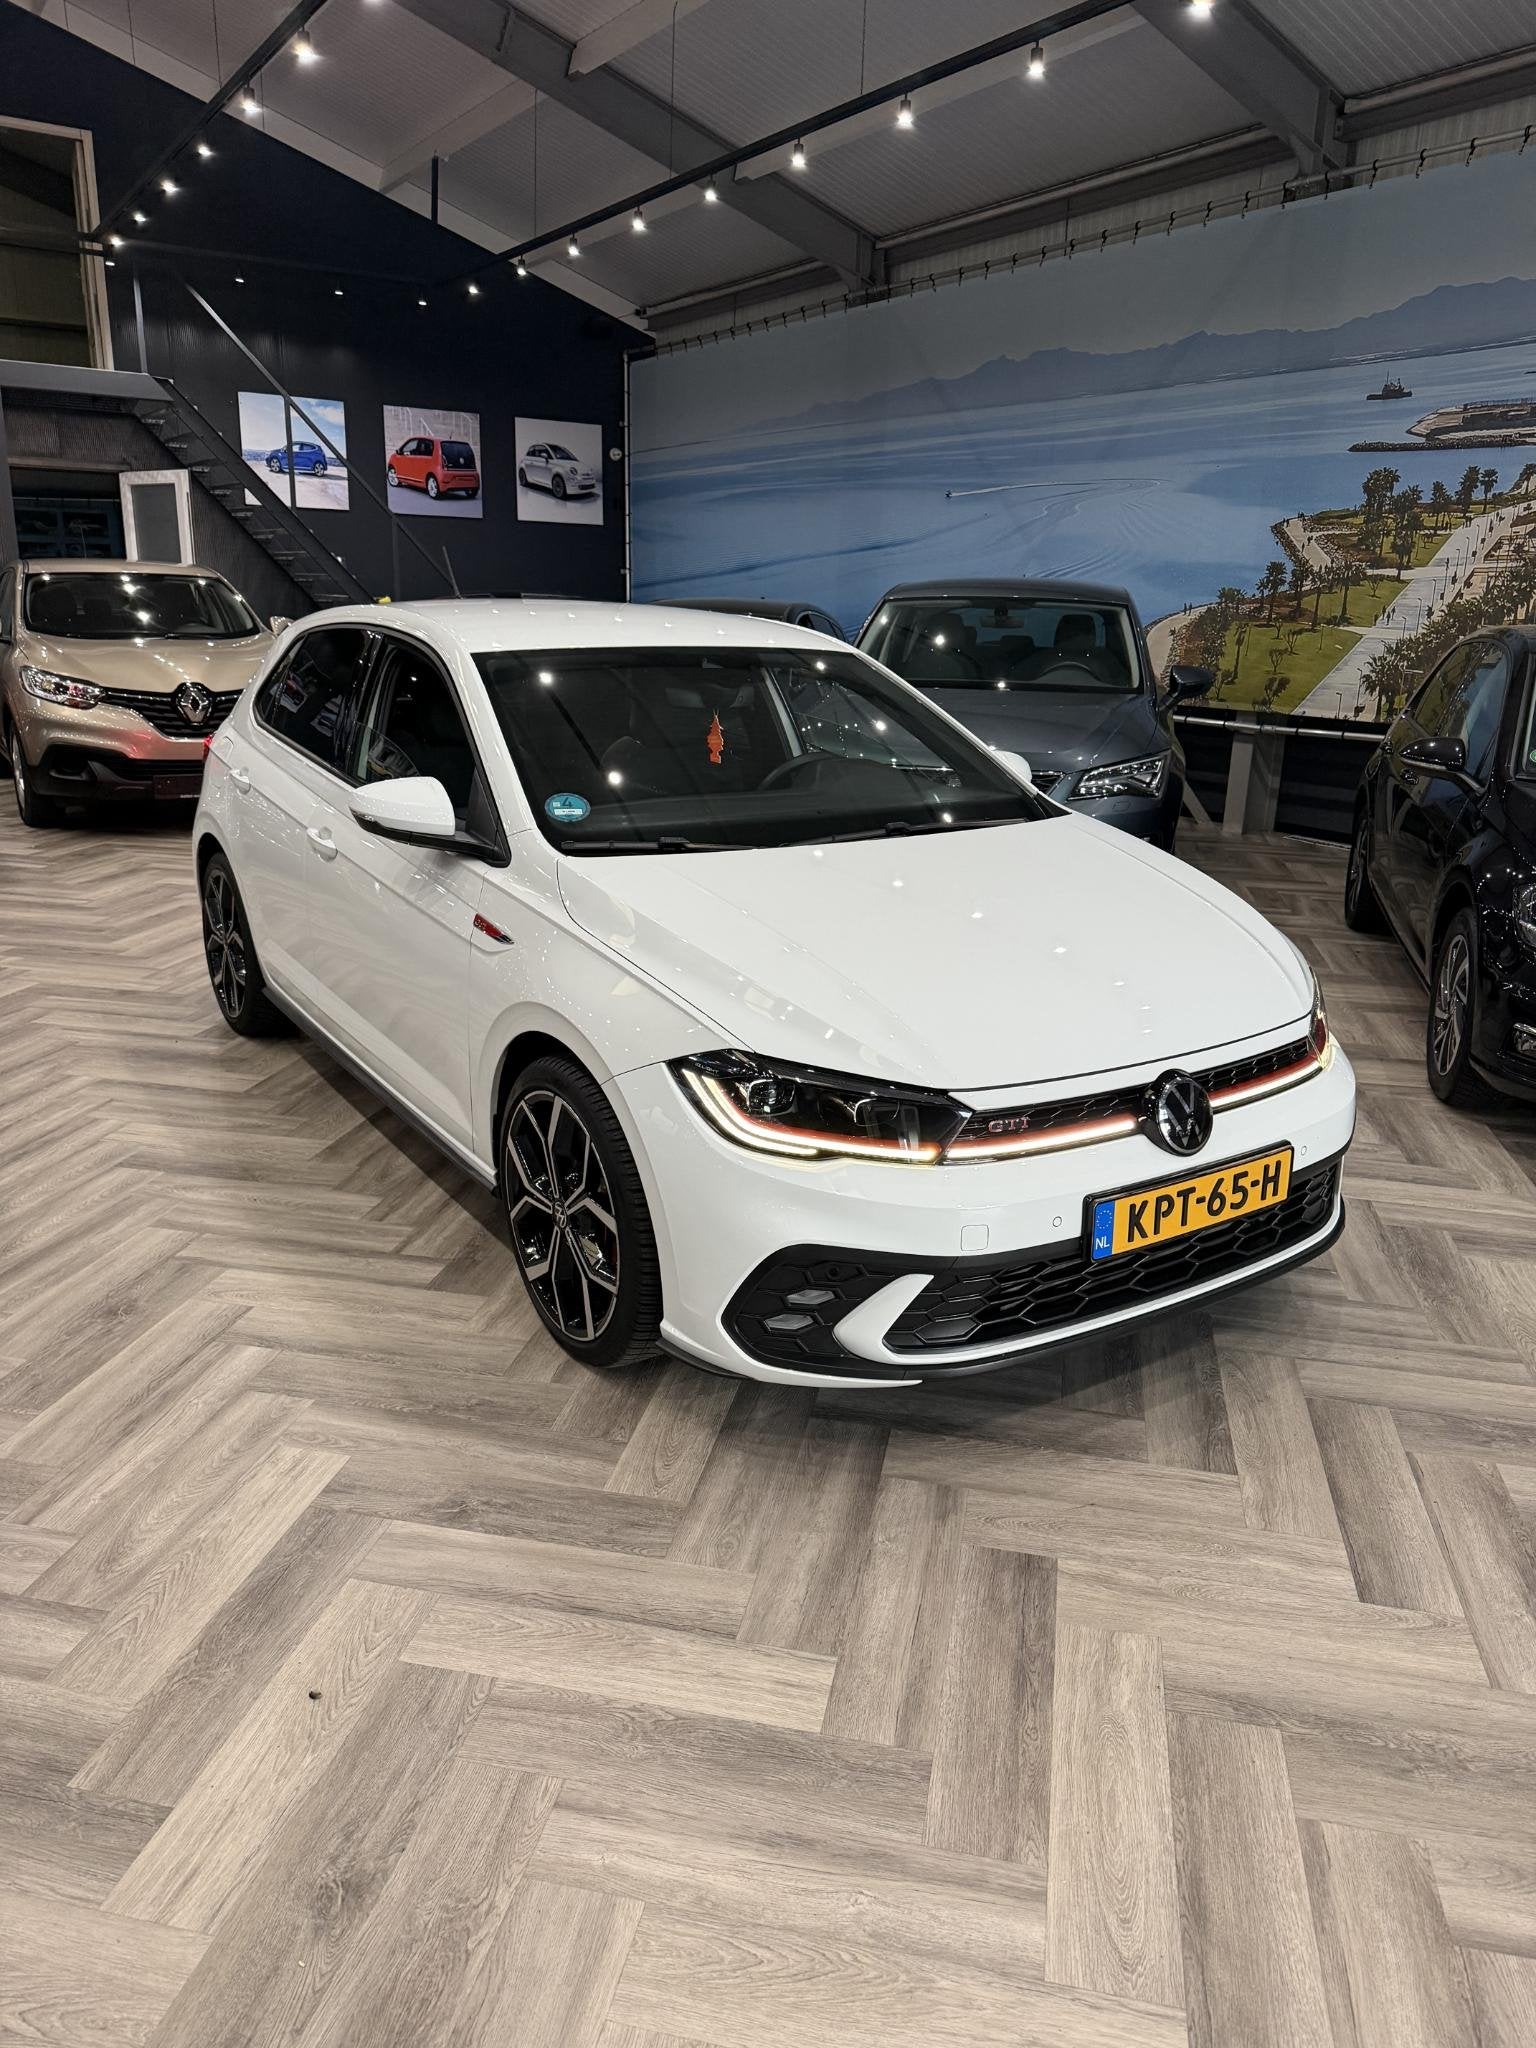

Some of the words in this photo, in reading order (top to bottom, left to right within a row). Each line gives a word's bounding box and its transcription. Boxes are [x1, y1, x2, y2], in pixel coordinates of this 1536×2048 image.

[988, 1116, 1031, 1133] GTI
[1127, 1160, 1282, 1243] KPT-65-H
[1095, 1236, 1110, 1250] NL
